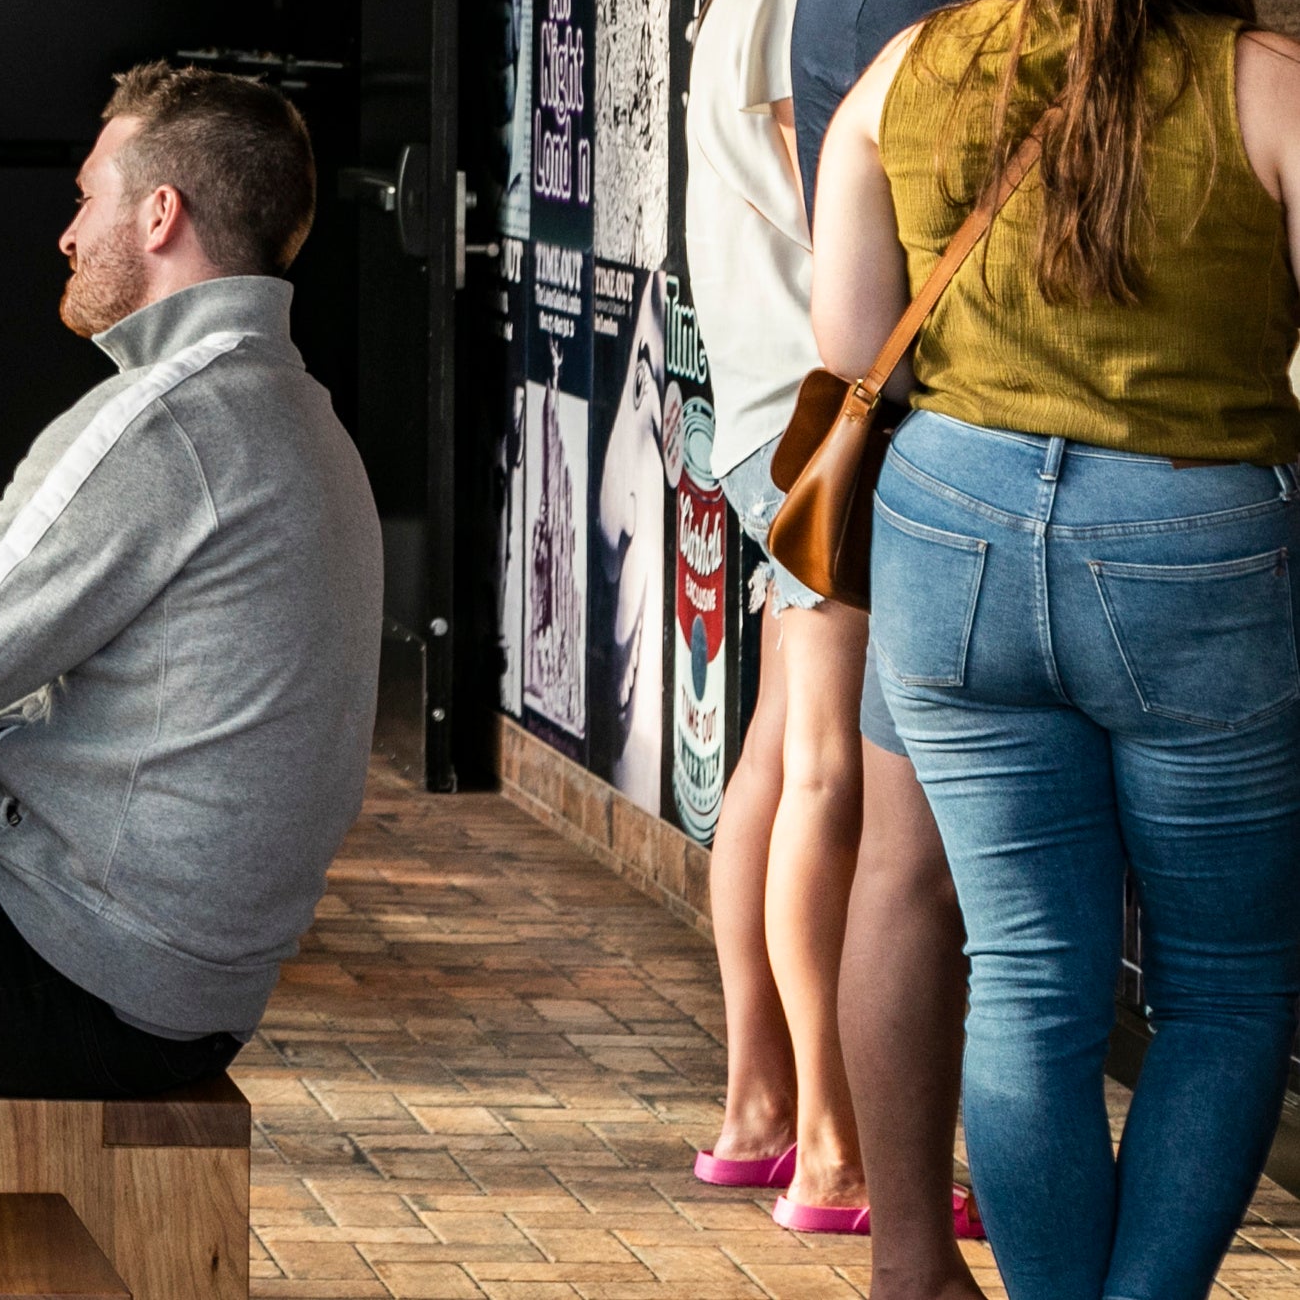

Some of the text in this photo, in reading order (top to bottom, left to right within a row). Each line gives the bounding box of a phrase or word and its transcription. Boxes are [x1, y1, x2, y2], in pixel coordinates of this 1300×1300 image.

[539, 19, 584, 124] Night
[535, 241, 583, 293] TIME OUT
[594, 266, 635, 302] TIME OUT
[665, 275, 707, 384] Time
[685, 573, 717, 612] EXCLUSIVE
[681, 681, 718, 745] TIME OUT
